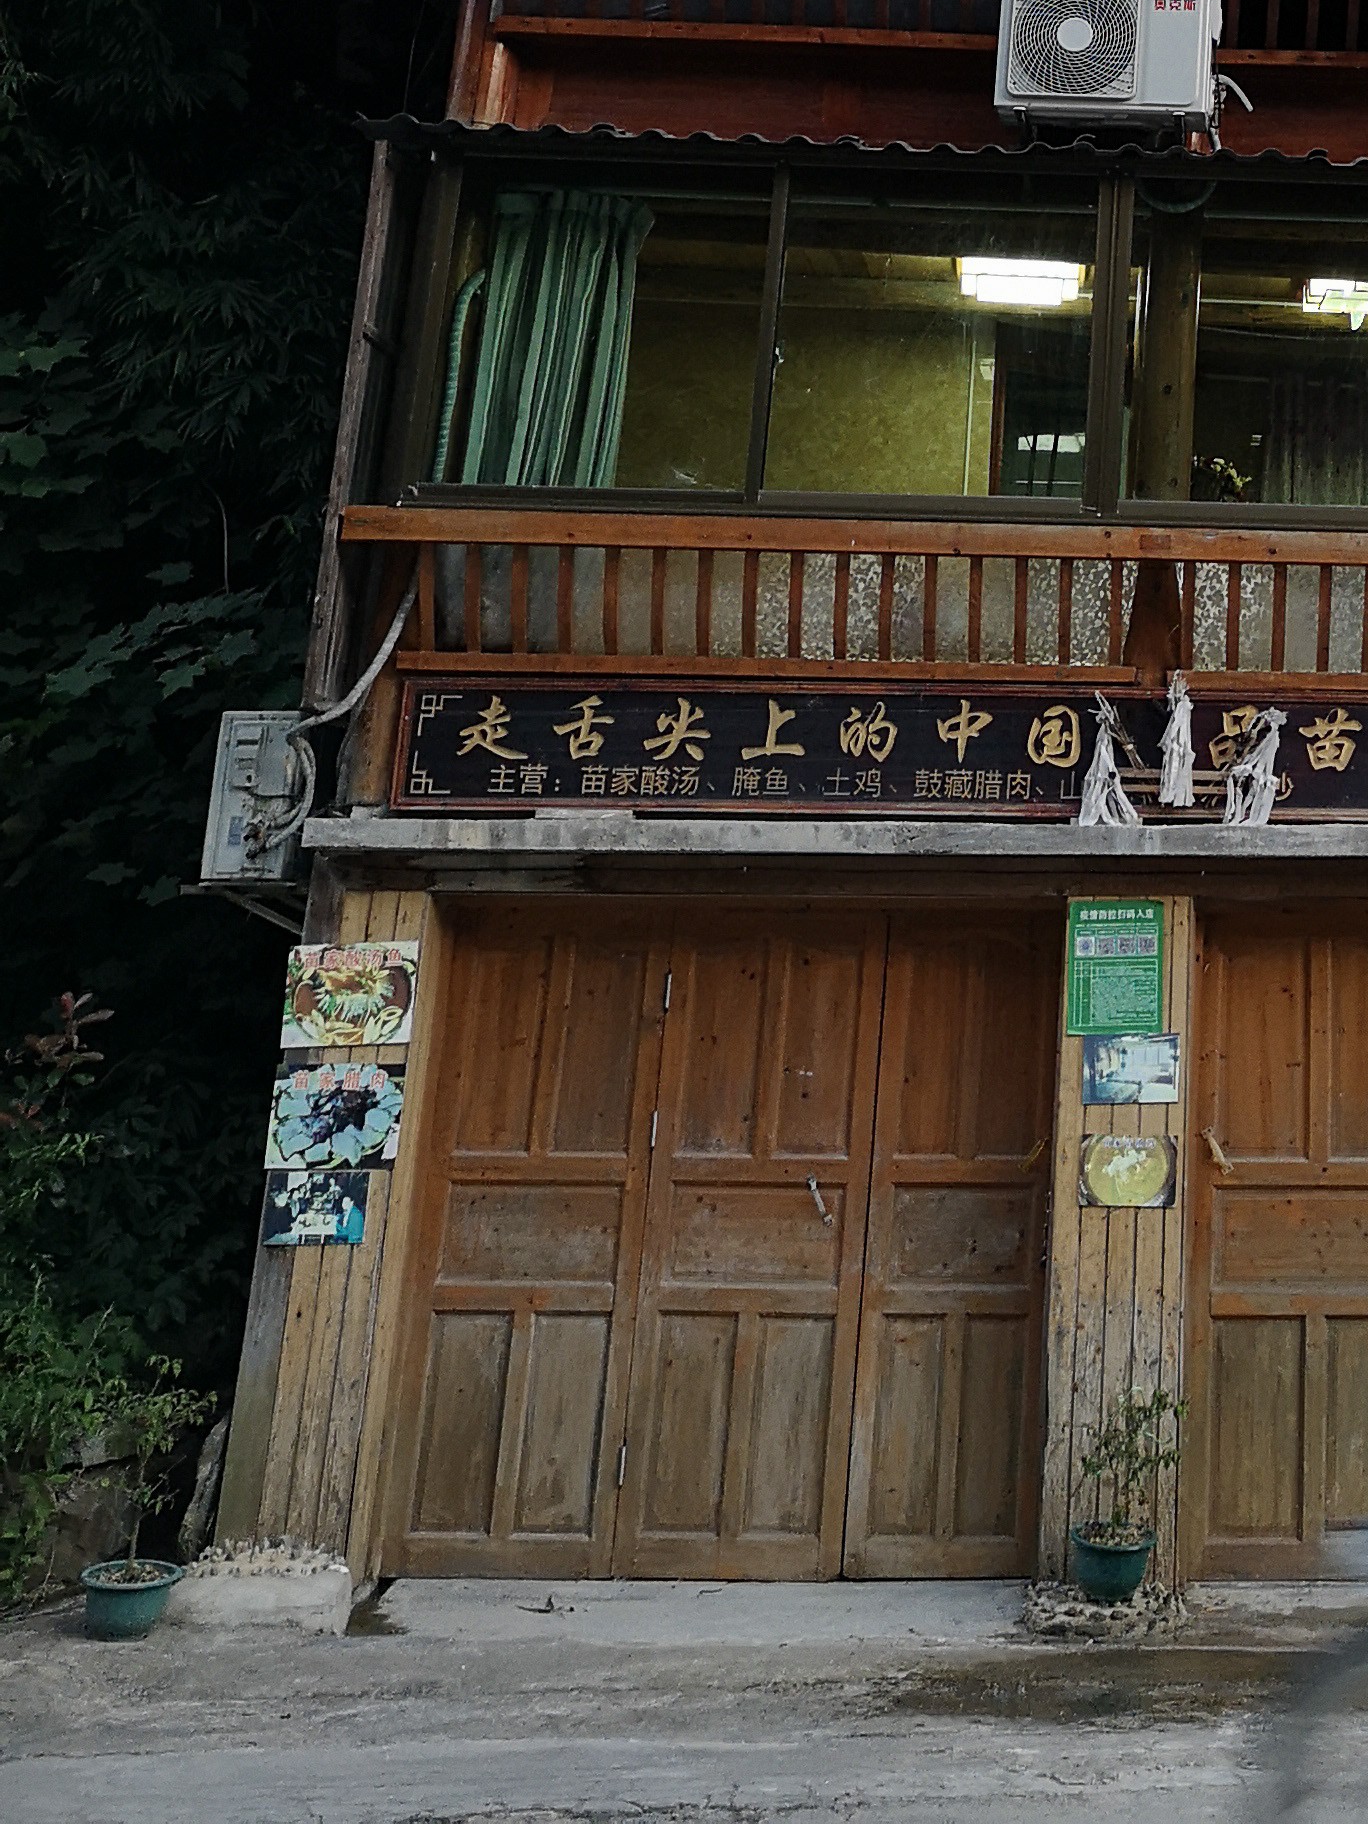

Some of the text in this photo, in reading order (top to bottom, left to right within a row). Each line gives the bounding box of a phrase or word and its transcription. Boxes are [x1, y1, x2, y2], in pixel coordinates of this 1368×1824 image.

[456, 695, 1081, 768] 走舌尖上的中国
